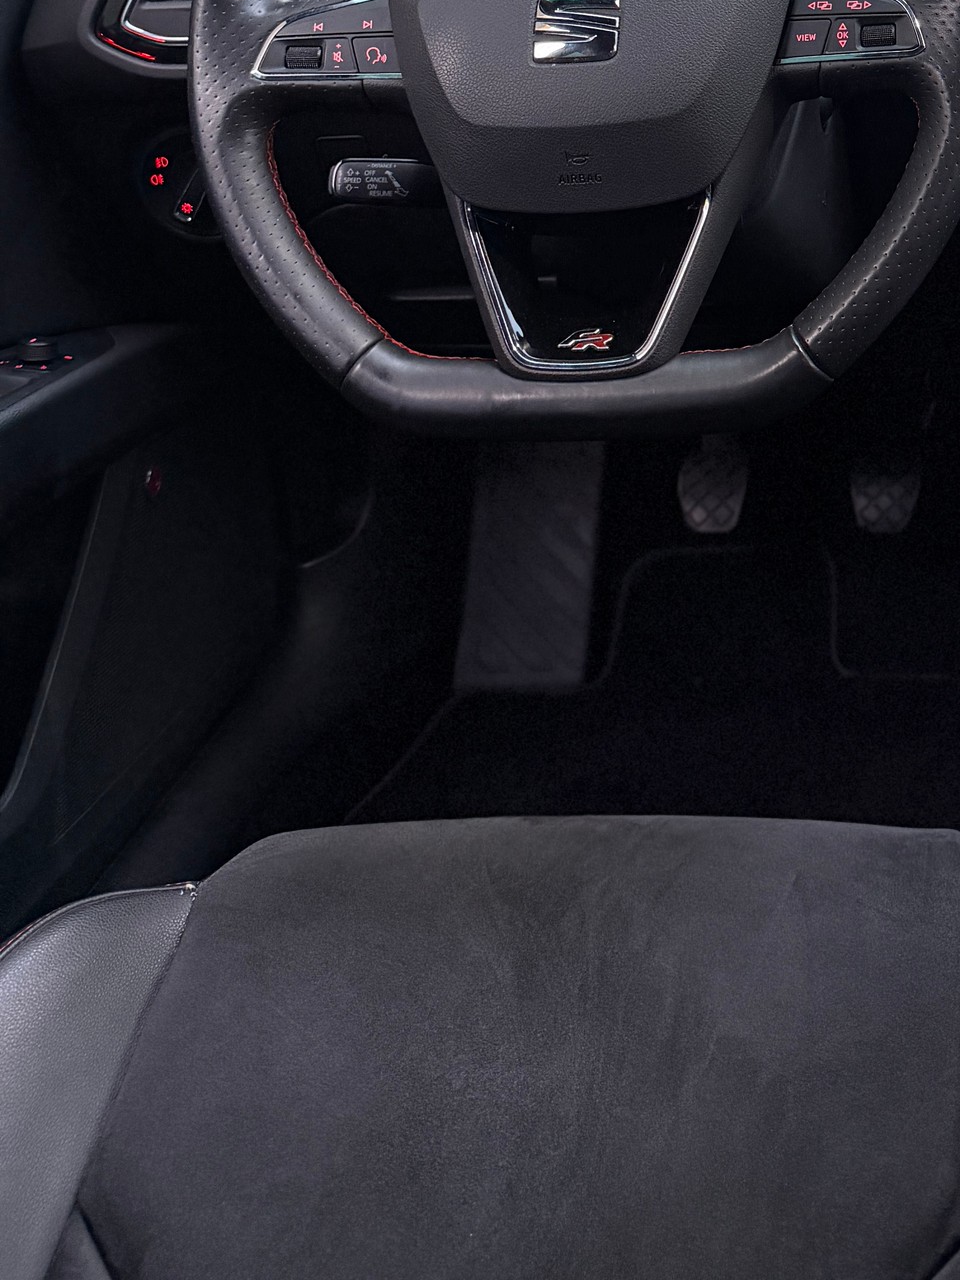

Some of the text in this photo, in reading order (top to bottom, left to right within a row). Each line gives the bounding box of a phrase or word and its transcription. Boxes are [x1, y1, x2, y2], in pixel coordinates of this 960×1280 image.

[796, 33, 817, 42] VIEW
[836, 31, 849, 40] OK
[343, 176, 362, 184] SPEED
[365, 176, 389, 184] CANCEL
[559, 173, 602, 186] AIRBAG
